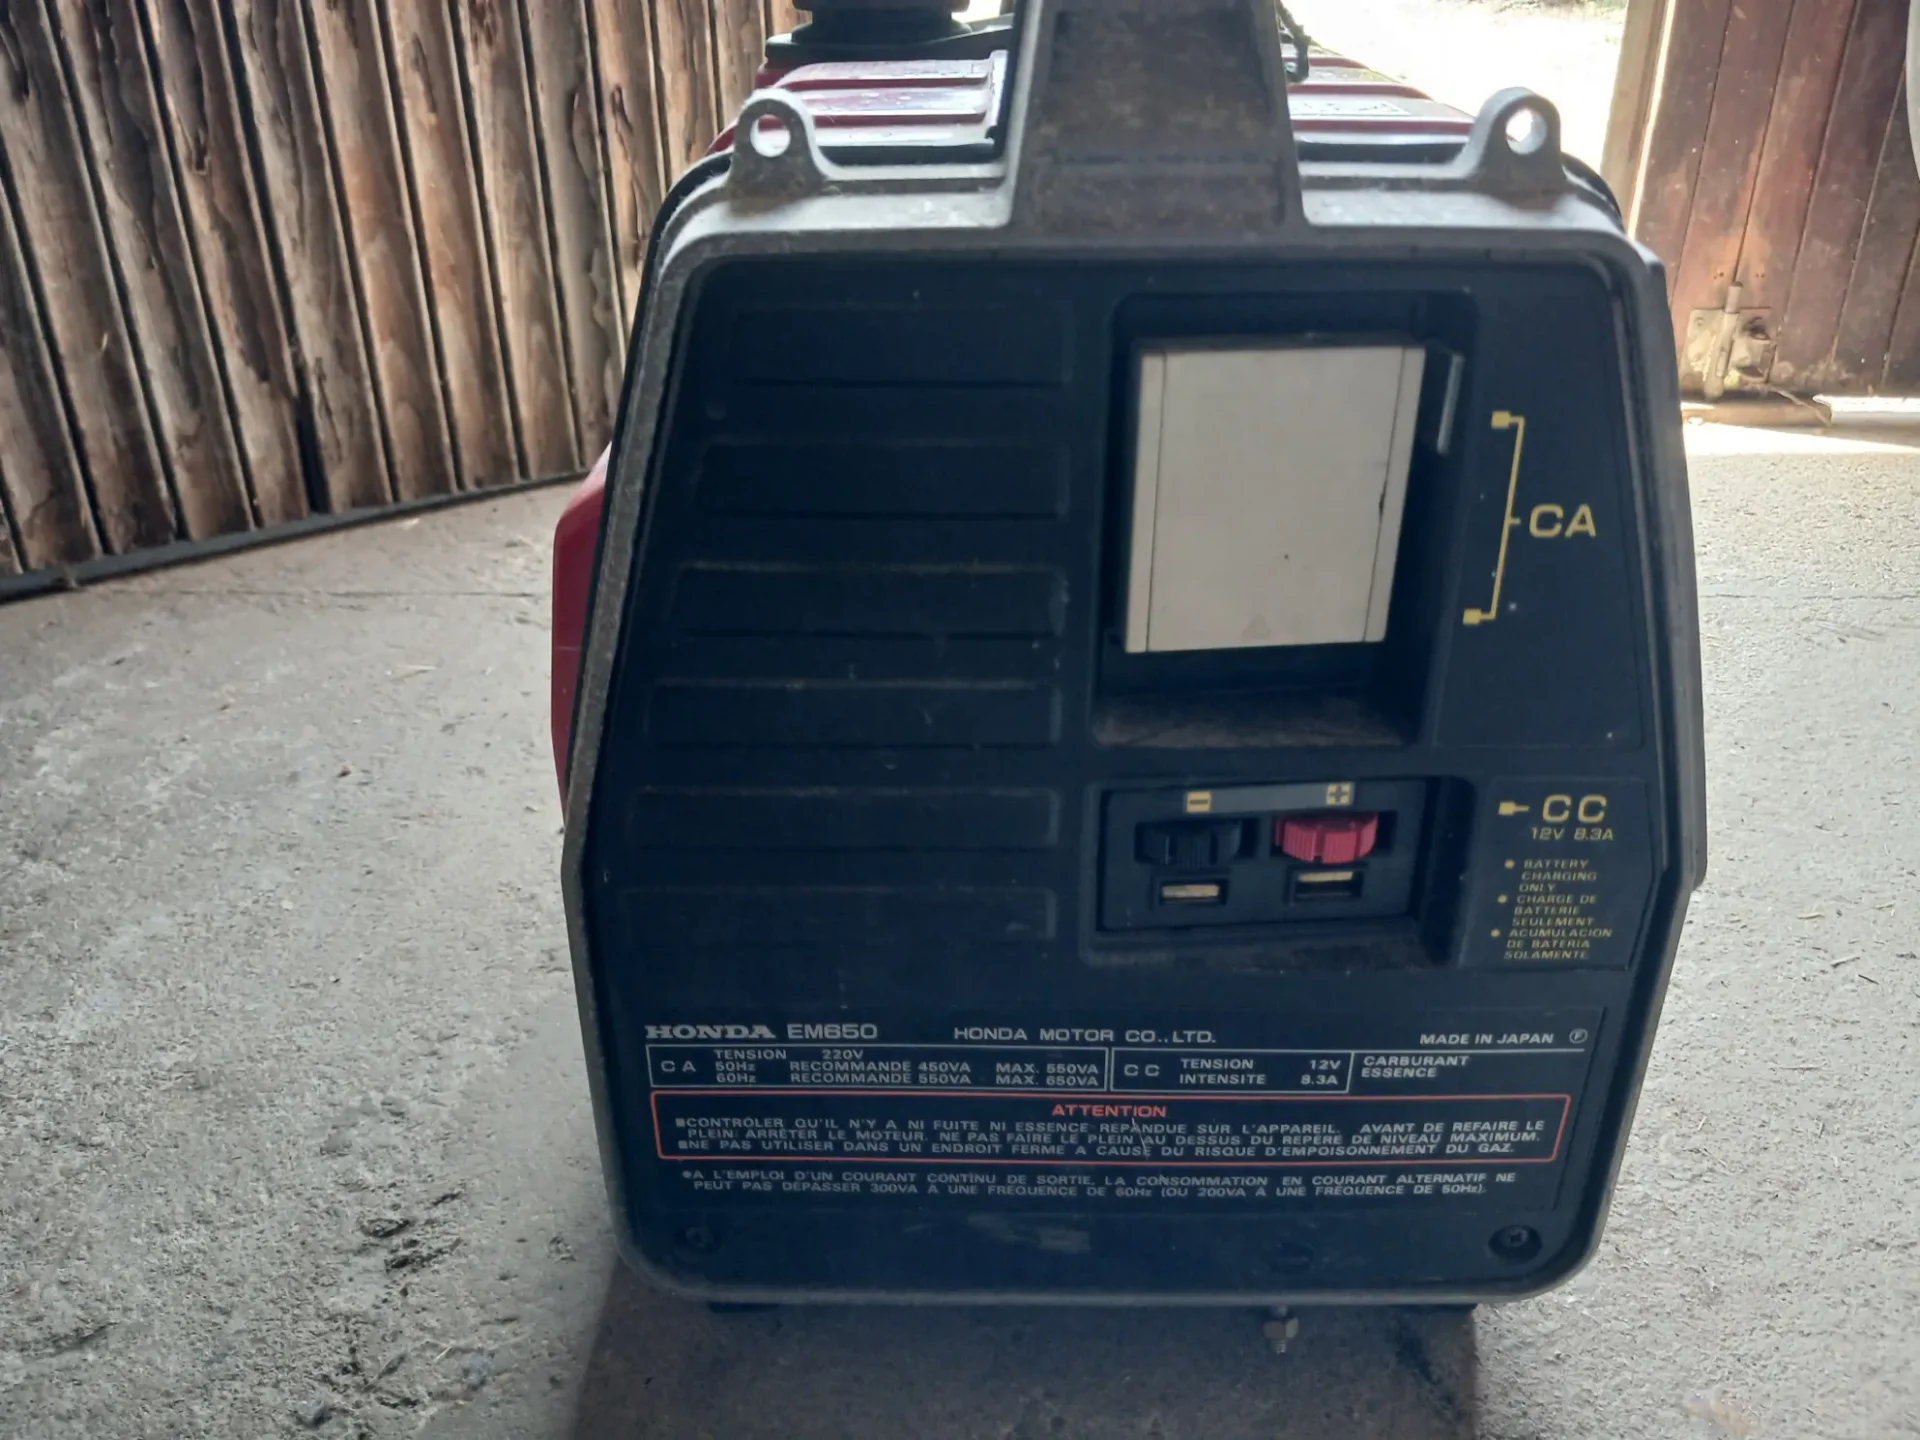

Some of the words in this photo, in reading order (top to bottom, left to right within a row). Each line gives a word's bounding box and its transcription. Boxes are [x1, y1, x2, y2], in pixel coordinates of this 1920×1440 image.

[1528, 503, 1597, 538] CA
[1542, 794, 1607, 823] CC
[1531, 827, 1565, 841] 12V
[1573, 827, 1614, 841] 8.3A
[1524, 859, 1589, 870] BATTERY
[1520, 871, 1597, 882] CHARGING
[1518, 883, 1557, 893] ONLY
[1516, 894, 1574, 904] CHARGE
[1580, 894, 1598, 904] DE
[1514, 906, 1580, 916] BATTERIE
[1512, 917, 1595, 927] SEULEMENT
[1506, 939, 1525, 949] DE
[1504, 950, 1589, 960] SOLAMENTE
[644, 1024, 777, 1039] HONDA
[786, 1023, 879, 1040] EM650
[954, 1027, 1028, 1041] HONDA
[1039, 1028, 1115, 1042] MOTOR
[1419, 1033, 1469, 1045] MADE
[1474, 1033, 1493, 1044] IN
[1496, 1032, 1554, 1044] JAPAN
[714, 1049, 787, 1060] TENSION
[822, 1049, 864, 1060] 220V
[1362, 1055, 1470, 1067] CARBURANT
[714, 1061, 756, 1072] 50Hz
[918, 1062, 971, 1073] 450VA
[995, 1062, 1040, 1074] MAX.
[1046, 1064, 1099, 1074] 550VA
[1180, 1058, 1254, 1070] TENSION
[1308, 1060, 1342, 1071] 12V
[1360, 1066, 1438, 1078] ESSENCE
[716, 1072, 757, 1084] 60Hz
[918, 1074, 972, 1085] 550VA
[995, 1075, 1040, 1086] MAX.
[1045, 1076, 1099, 1086] 650VA
[1179, 1073, 1267, 1085] INTENSITE
[1300, 1074, 1339, 1086] 8.3A
[1052, 1104, 1167, 1118] ATTENTION
[794, 1118, 839, 1130] QU'IL
[850, 1119, 877, 1130] N'Y
[886, 1120, 898, 1130] A
[908, 1120, 925, 1130] NI
[933, 1120, 980, 1132] FUITE
[990, 1121, 1007, 1132] NI
[1015, 1121, 1090, 1134] ESSENCE
[1196, 1124, 1232, 1135] SUR
[1360, 1122, 1416, 1134] AVANT
[1422, 1122, 1445, 1133] DE
[1452, 1121, 1518, 1132] REFAIRE
[1526, 1120, 1545, 1131] LE
[828, 1130, 847, 1140] LE
[856, 1130, 928, 1142] MOTEUR.
[940, 1131, 960, 1142] NE
[968, 1132, 1000, 1143] PAS
[1006, 1132, 1052, 1144] FAIRE
[1060, 1134, 1079, 1144] LE
[1087, 1134, 1134, 1145] PLEIN
[1144, 1134, 1167, 1146] AU
[1175, 1135, 1241, 1146] DESSUS
[1250, 1135, 1274, 1146] DU
[1352, 1134, 1372, 1145] DE
[1380, 1133, 1442, 1144] NIVEAU
[1450, 1131, 1541, 1142] MAXIMUM.
[688, 1140, 710, 1150] NE
[720, 1140, 752, 1150] PAS
[762, 1140, 834, 1151] UTILISER
[844, 1141, 890, 1152] DANS
[898, 1142, 922, 1152] UN
[932, 1143, 1003, 1154] ENDROIT
[1096, 1146, 1153, 1156] CAUSE
[1160, 1146, 1185, 1156] DU
[1194, 1146, 1256, 1156] RISQUE
[1264, 1144, 1437, 1156] D'EMPOISONNEMENT
[1446, 1143, 1470, 1154] DU
[1478, 1142, 1515, 1153] GAZ.
[713, 1170, 785, 1180] L'EMPLOI
[794, 1170, 834, 1182] D'UN
[842, 1172, 918, 1182] COURANT
[926, 1172, 997, 1184] CONTINU
[1007, 1174, 1028, 1185] DE
[1104, 1176, 1126, 1186] LA
[1136, 1176, 1268, 1186] CONSOMMATION
[1282, 1176, 1304, 1186] EN
[1312, 1174, 1388, 1186] COURANT
[1396, 1173, 1488, 1184] ALTERNATIF
[1496, 1172, 1517, 1183] NE
[694, 1180, 734, 1190] PEUT
[742, 1180, 773, 1191] PAS
[870, 1182, 918, 1194] 300VA
[948, 1184, 979, 1195] UNE
[1086, 1186, 1107, 1197] DE
[1160, 1186, 1189, 1198] (OU
[1198, 1187, 1247, 1198] 200VA
[1276, 1186, 1307, 1197] UNE
[1413, 1184, 1434, 1195] DE
